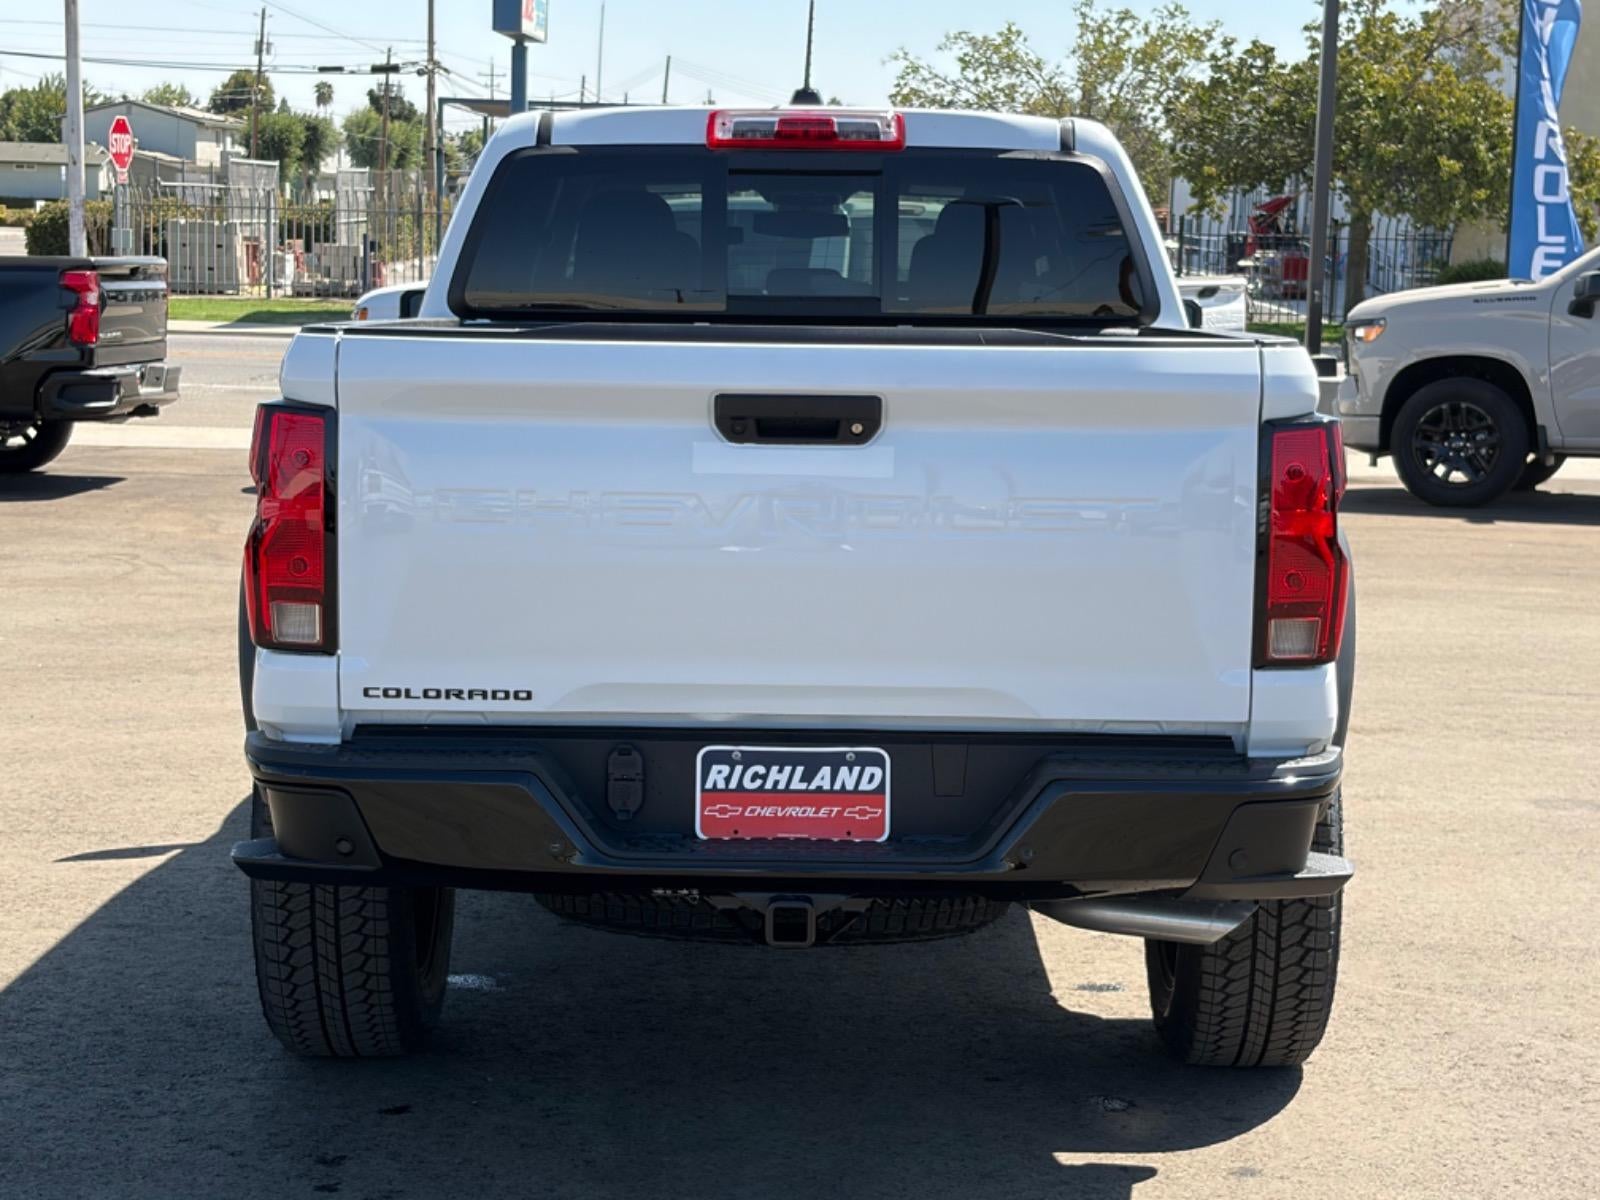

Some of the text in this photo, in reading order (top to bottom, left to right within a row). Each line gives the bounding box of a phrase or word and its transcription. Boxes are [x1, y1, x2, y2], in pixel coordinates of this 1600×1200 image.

[110, 132, 131, 154] STOP
[362, 686, 533, 701] COLORADO
[704, 764, 883, 791] RICHLAND
[744, 806, 842, 817] CHEVROLET
